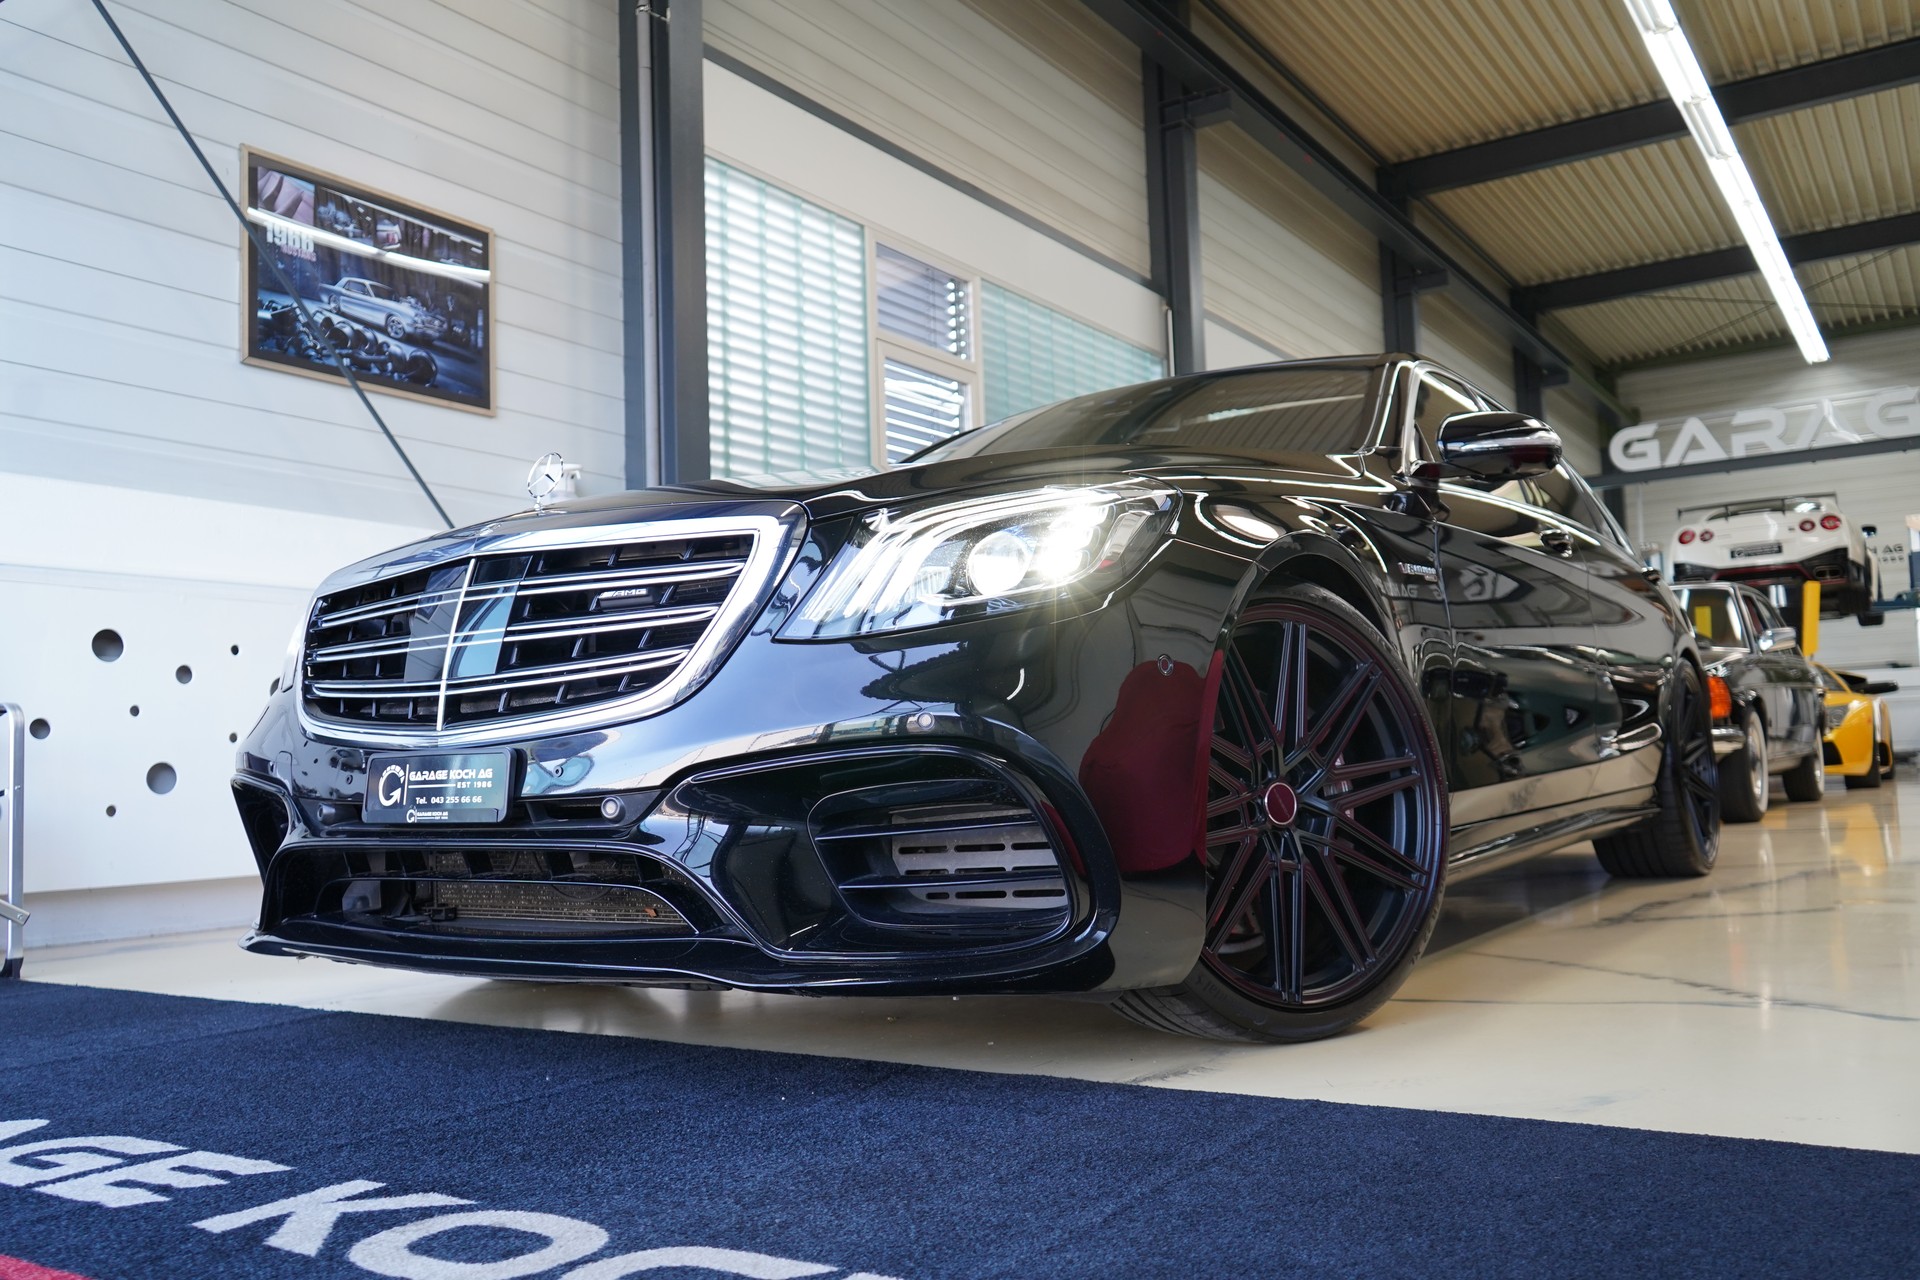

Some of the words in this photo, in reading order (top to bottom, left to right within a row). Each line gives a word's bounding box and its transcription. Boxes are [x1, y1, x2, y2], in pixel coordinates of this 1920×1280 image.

[612, 588, 647, 597] AMG
[409, 770, 448, 780] GARAGE
[449, 769, 476, 780] KOCH
[478, 768, 493, 779] AG
[431, 796, 444, 804] 043
[472, 795, 482, 803] 66
